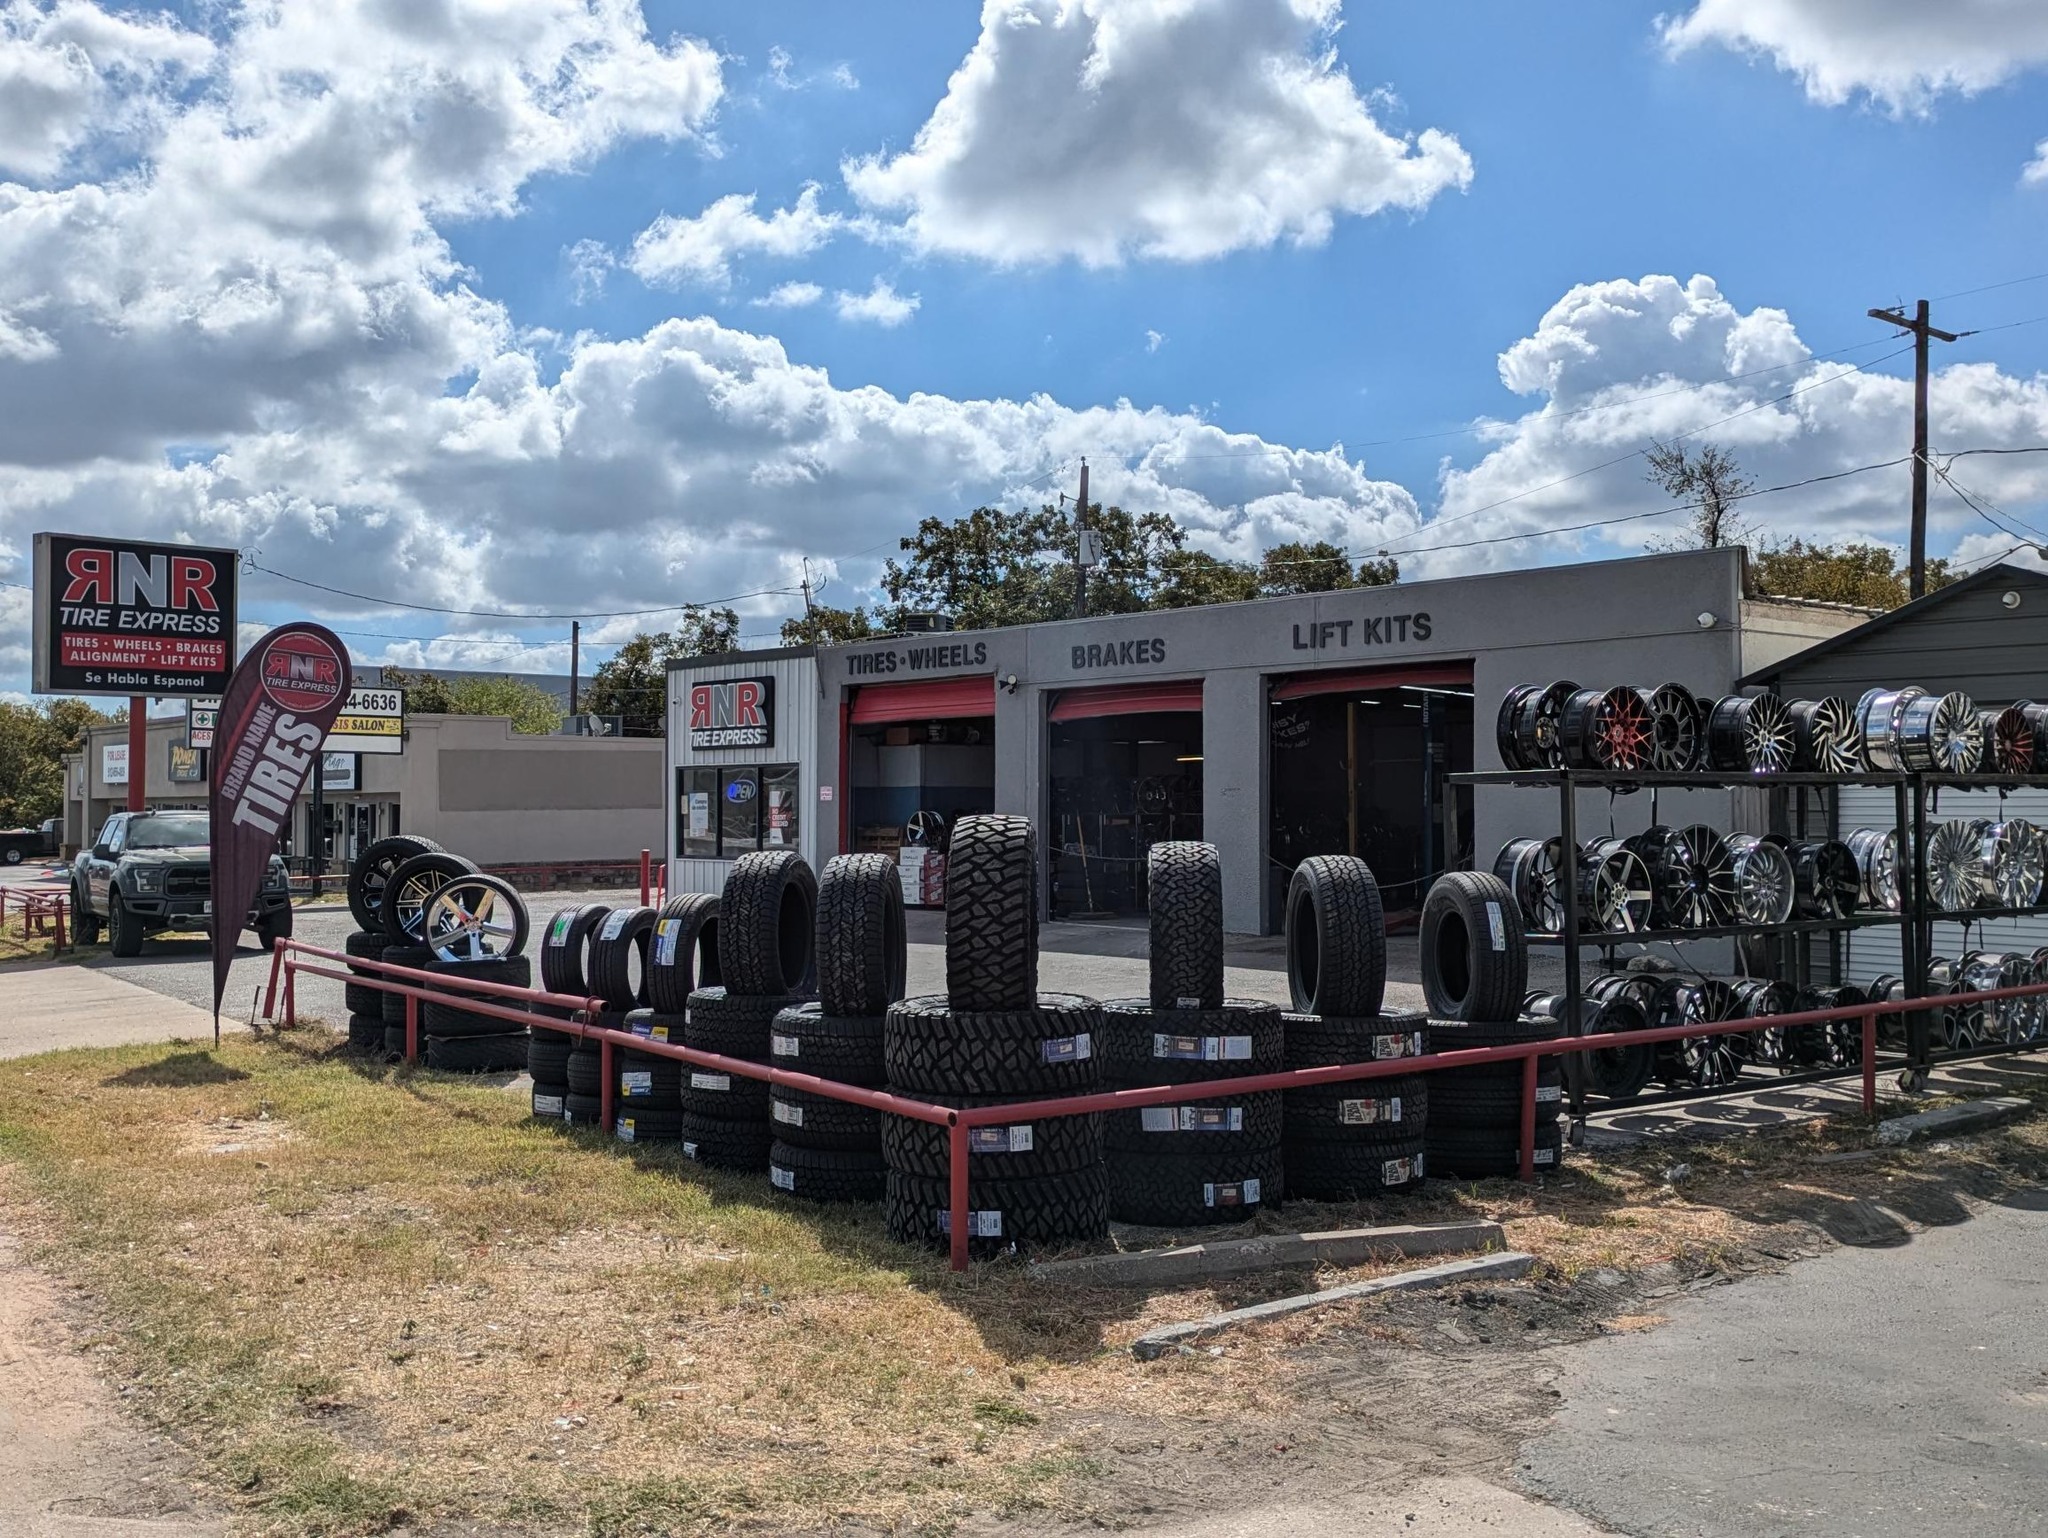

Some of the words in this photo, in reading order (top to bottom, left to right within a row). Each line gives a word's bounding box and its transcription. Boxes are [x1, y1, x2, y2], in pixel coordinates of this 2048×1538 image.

[60, 606, 111, 628] TIRE
[118, 610, 221, 634] EXPRESS
[1293, 620, 1353, 650] LIFT
[1363, 612, 1433, 645] KITS
[64, 636, 99, 648] TIRES
[113, 639, 162, 651] WHEELS
[176, 642, 223, 654] BRAKES
[1071, 638, 1166, 669] BRAKES
[70, 651, 147, 664] ALIGNMENT
[160, 655, 185, 665] LIFT
[190, 656, 217, 667] KITS
[85, 672, 102, 683] Se
[107, 672, 148, 685] Habla
[154, 674, 205, 688] Espanol
[266, 677, 290, 688] TIRE
[291, 680, 337, 694] EXPRESS
[352, 719, 386, 731] SALON
[689, 730, 711, 747] TIRE
[712, 729, 764, 746] EXPRESS
[220, 745, 256, 800] BRAND
[243, 702, 277, 748] NAME
[231, 713, 322, 836] TIRES
[728, 783, 752, 799] OPEN
